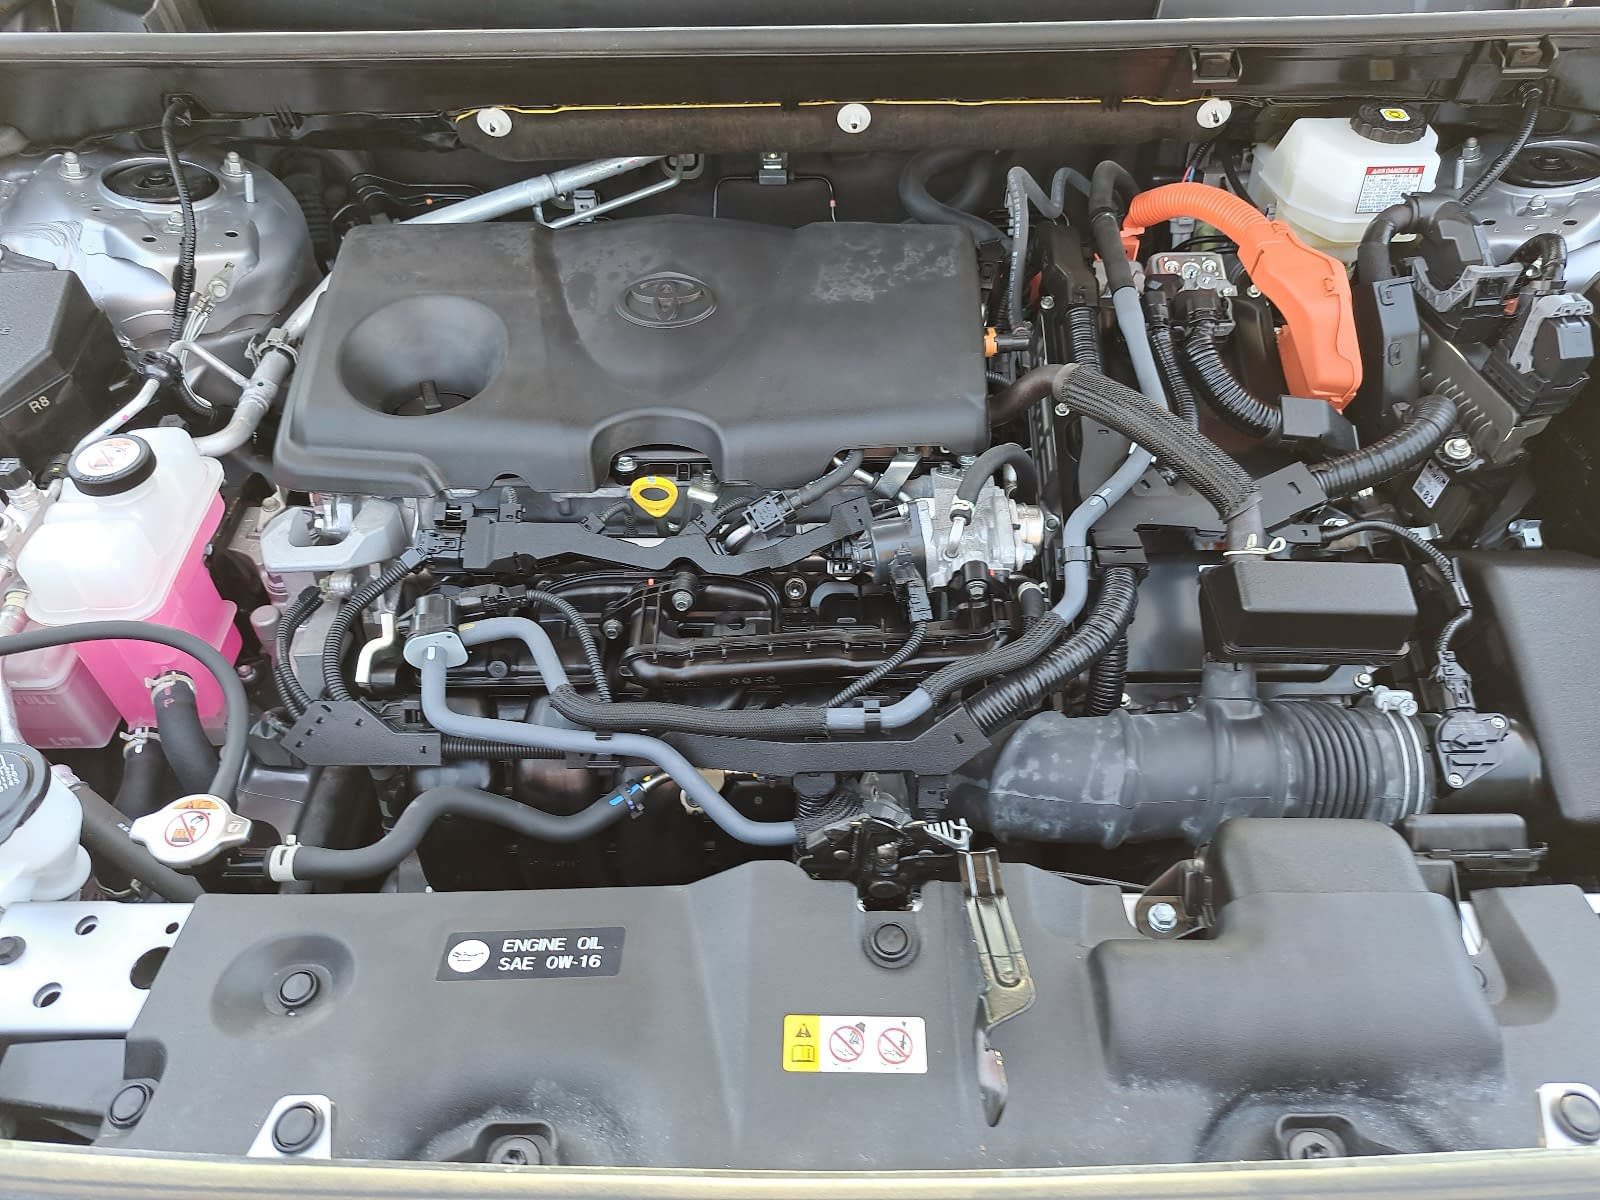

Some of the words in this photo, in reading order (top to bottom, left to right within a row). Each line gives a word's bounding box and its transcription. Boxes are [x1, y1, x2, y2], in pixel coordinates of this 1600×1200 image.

[28, 395, 50, 414] R8
[15, 695, 57, 705] FULL
[501, 937, 568, 953] ENGINE
[576, 936, 605, 950] OIL
[497, 956, 537, 971] SAE
[545, 954, 603, 970] 0W-16
